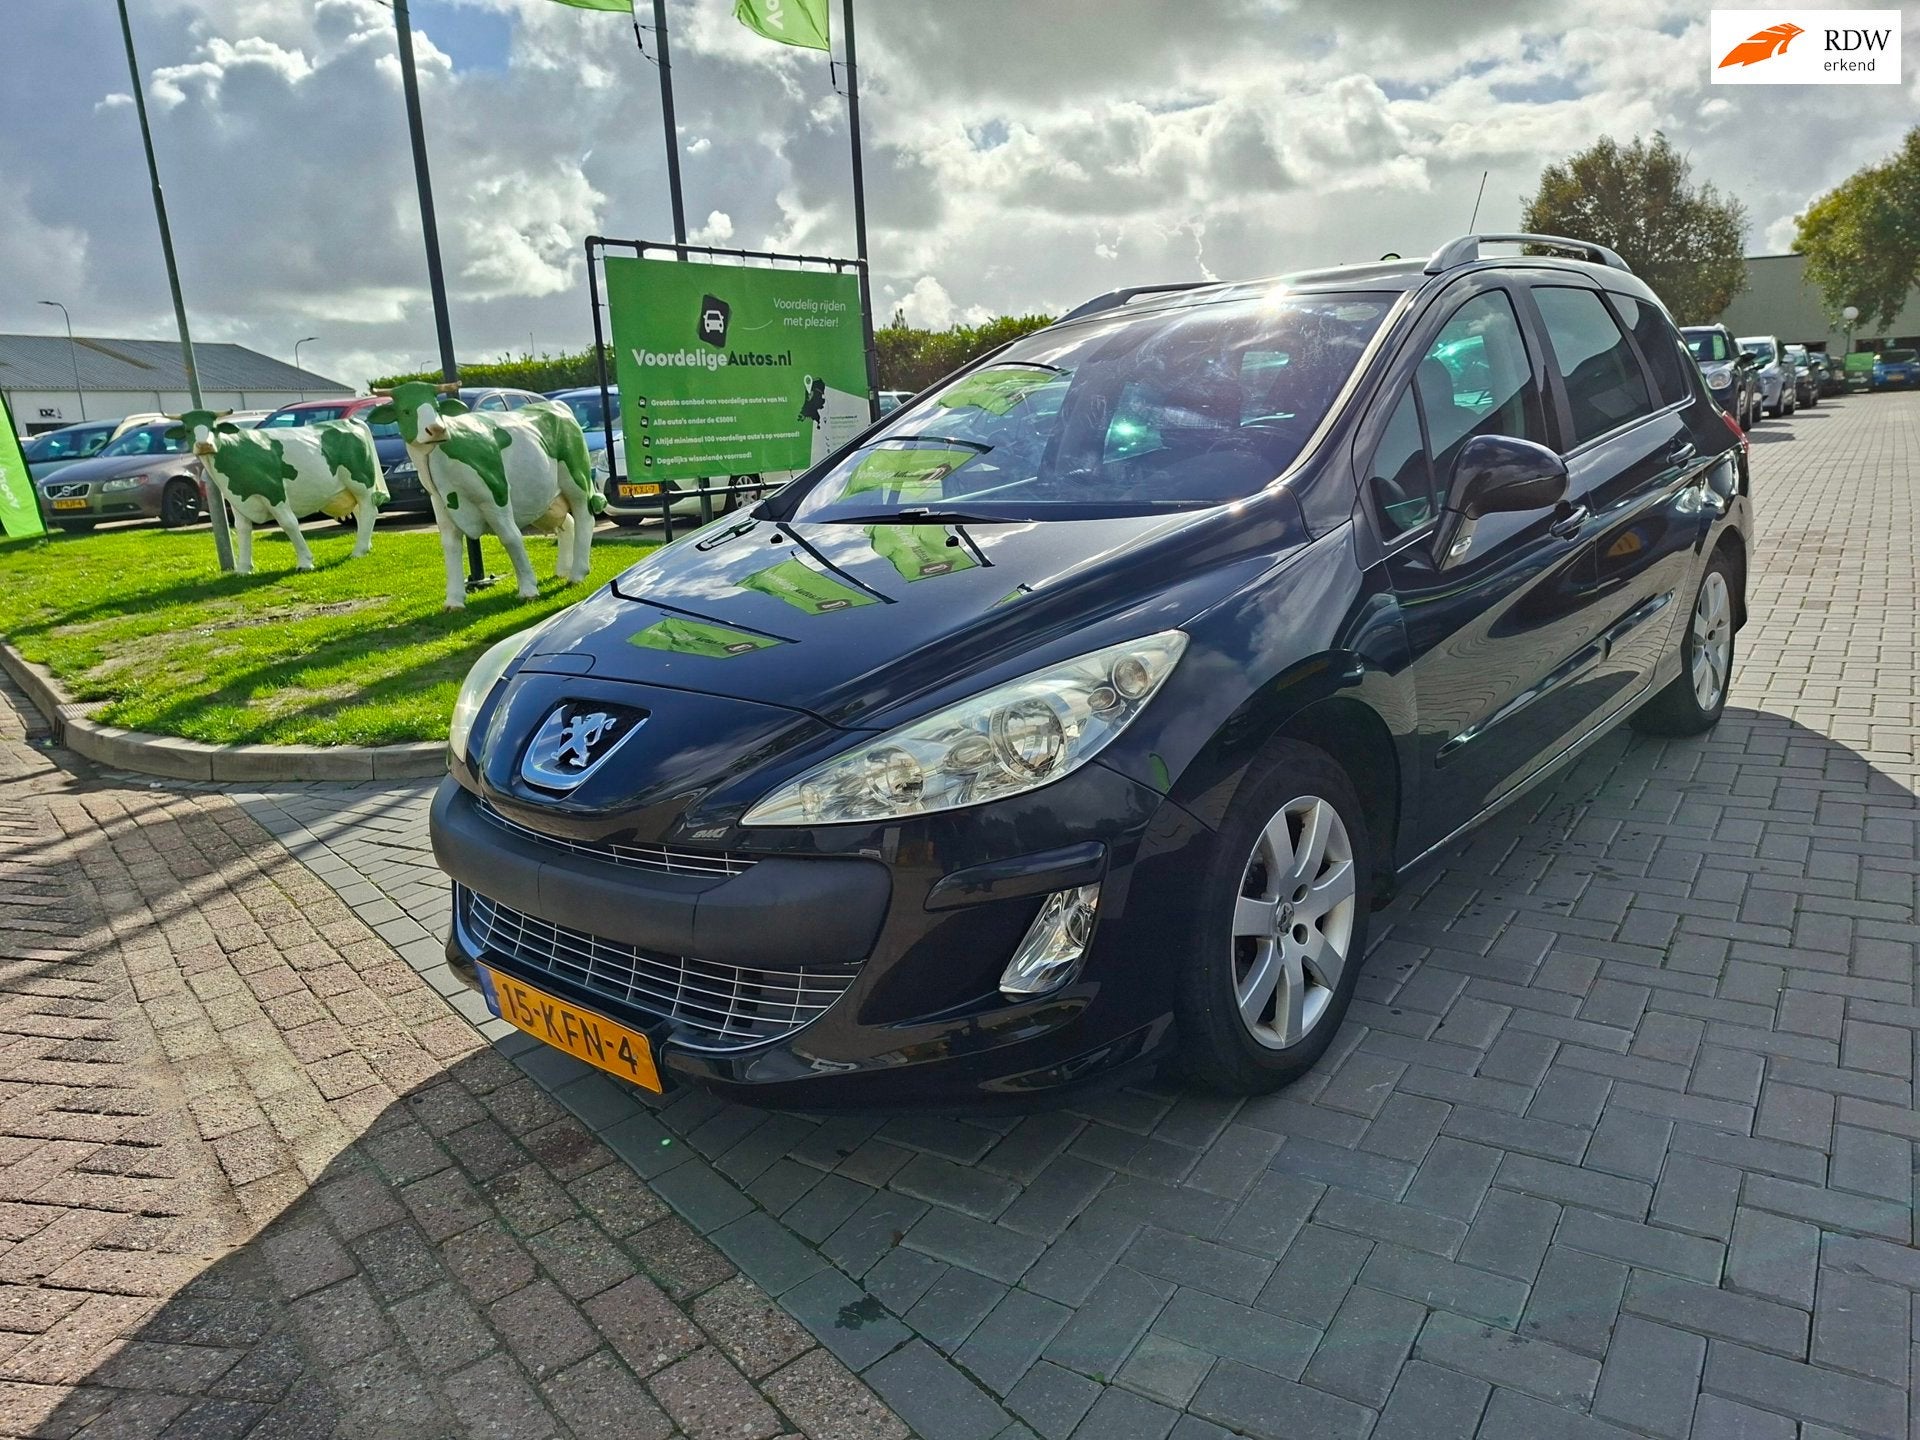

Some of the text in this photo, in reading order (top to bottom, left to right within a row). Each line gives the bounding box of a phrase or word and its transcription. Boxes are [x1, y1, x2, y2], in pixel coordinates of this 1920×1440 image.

[773, 298, 846, 313] Voordelig rijden
[783, 316, 839, 329] met plezier!
[632, 348, 792, 371] VoordeligeAutos.nl
[502, 983, 638, 1075] 15-KFN-4
